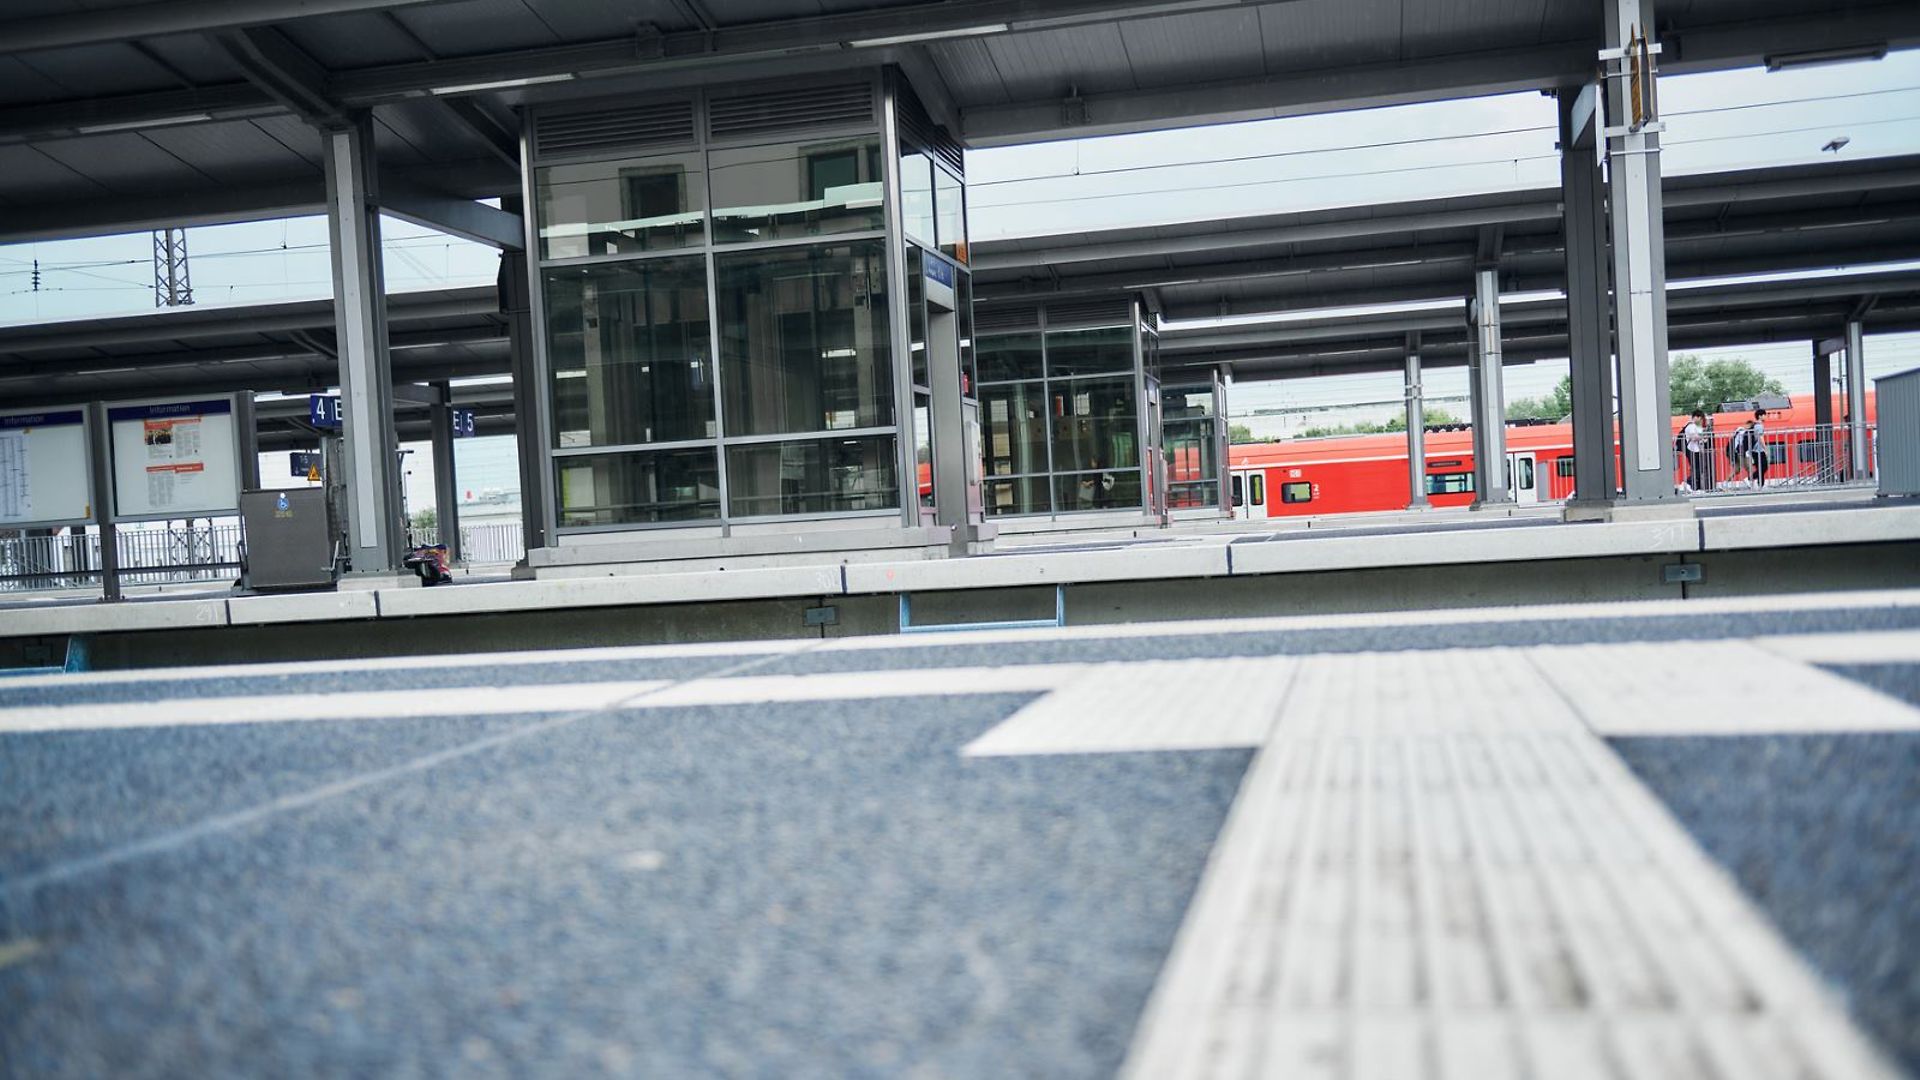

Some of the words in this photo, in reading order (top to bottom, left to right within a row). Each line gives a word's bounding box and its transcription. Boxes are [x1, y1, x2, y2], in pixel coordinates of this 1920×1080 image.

[148, 403, 192, 413] Information
[316, 397, 326, 420] 4
[334, 398, 343, 421] E
[452, 410, 460, 430] E
[467, 412, 474, 432] 5
[1313, 483, 1320, 492] 2
